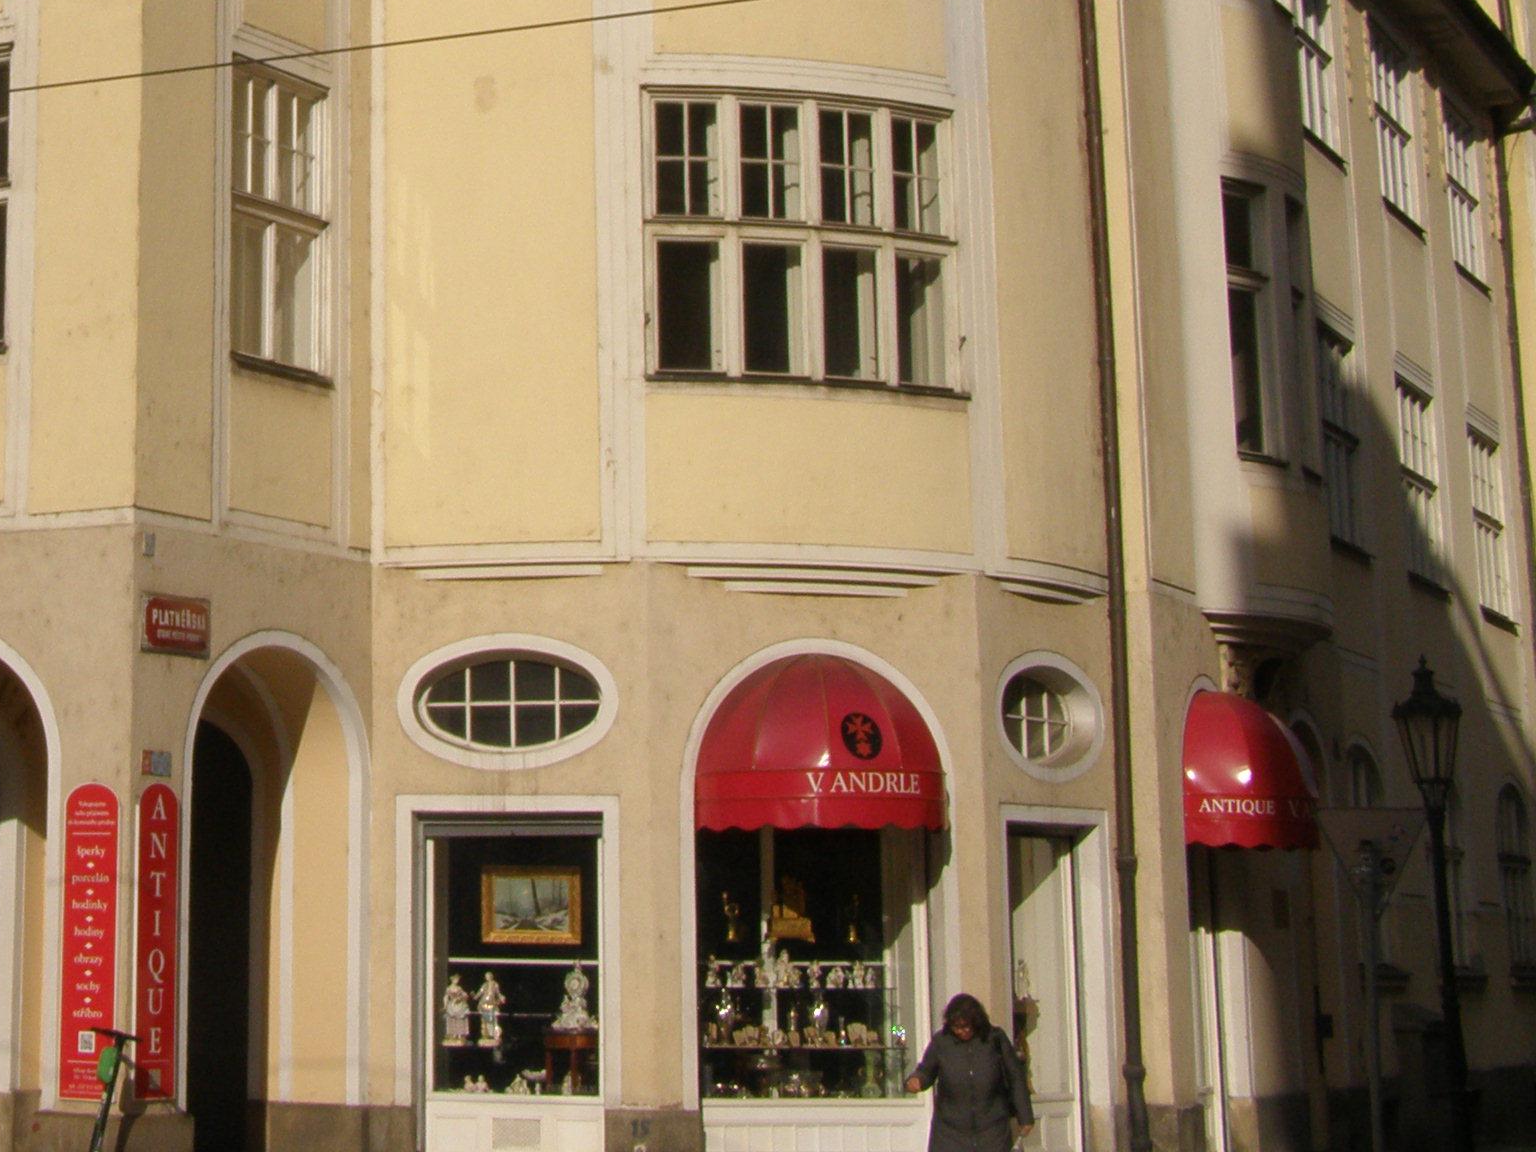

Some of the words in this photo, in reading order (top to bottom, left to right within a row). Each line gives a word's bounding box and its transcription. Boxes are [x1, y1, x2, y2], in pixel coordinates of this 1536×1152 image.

[830, 771, 921, 795] ANDRLE
[1198, 798, 1275, 816] ANTIQUE
[72, 899, 108, 911] hodinky
[147, 793, 167, 1055] ANTIQUE
[74, 927, 104, 939] hodiny
[74, 953, 103, 966] obrazy
[76, 981, 101, 993] sochy
